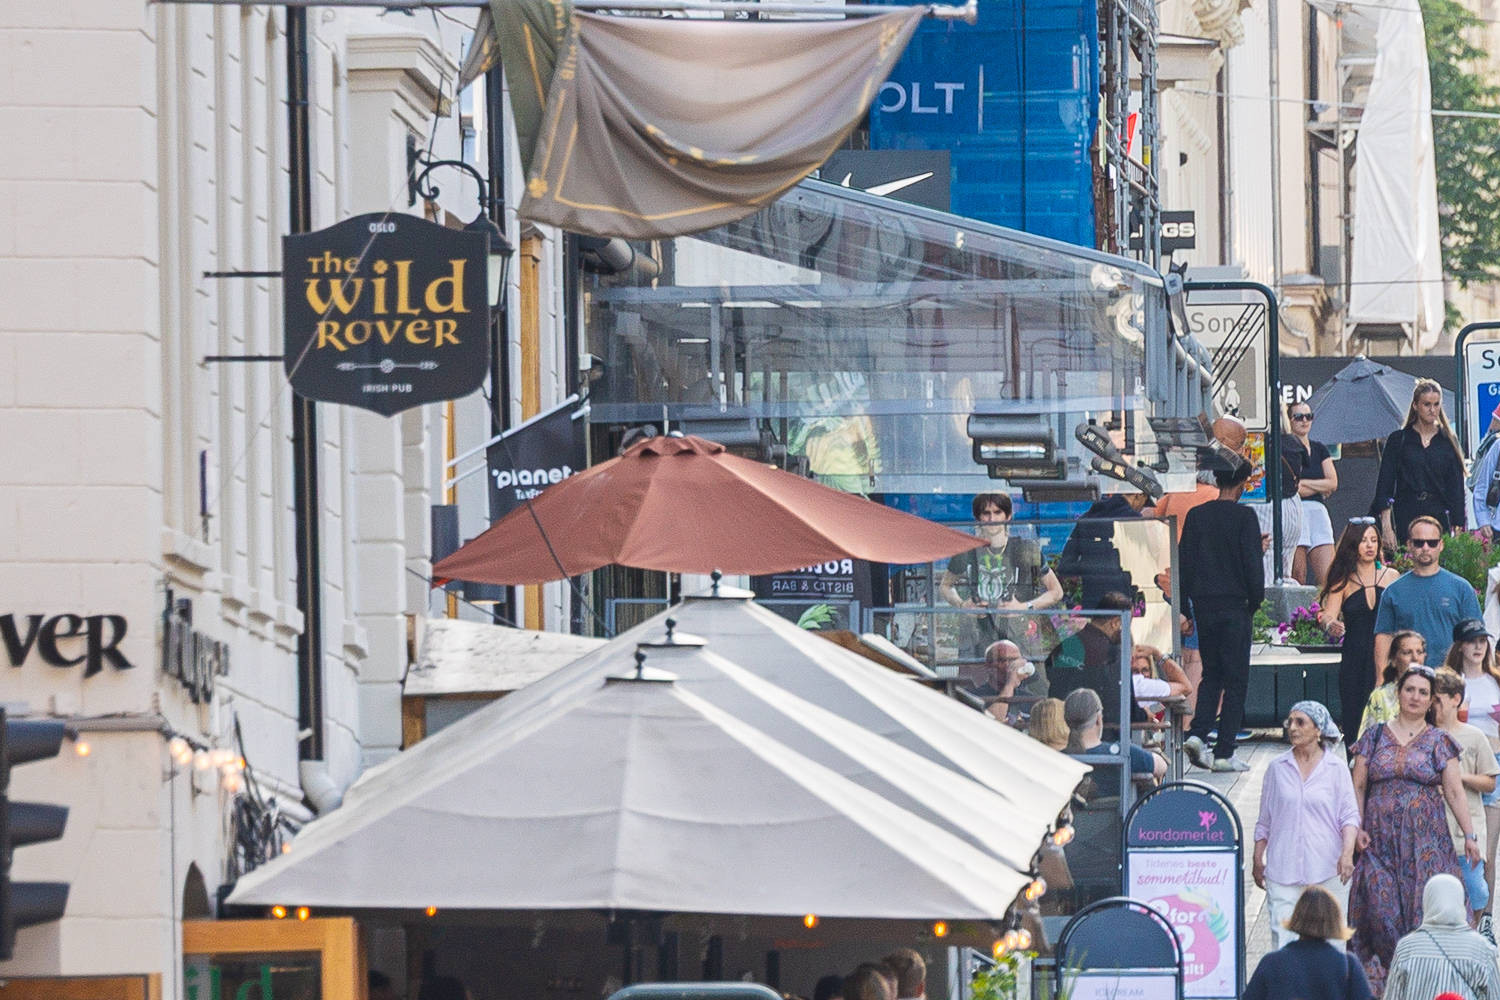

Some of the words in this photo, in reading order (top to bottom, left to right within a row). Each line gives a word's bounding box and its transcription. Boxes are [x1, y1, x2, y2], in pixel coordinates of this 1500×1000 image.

[369, 222, 395, 233] OSLO
[307, 251, 361, 273] The
[363, 384, 389, 393] IRISH
[392, 384, 412, 393] PUB
[492, 466, 571, 489] planet
[1138, 828, 1225, 842] kondomeriet
[1169, 907, 1197, 924] for
